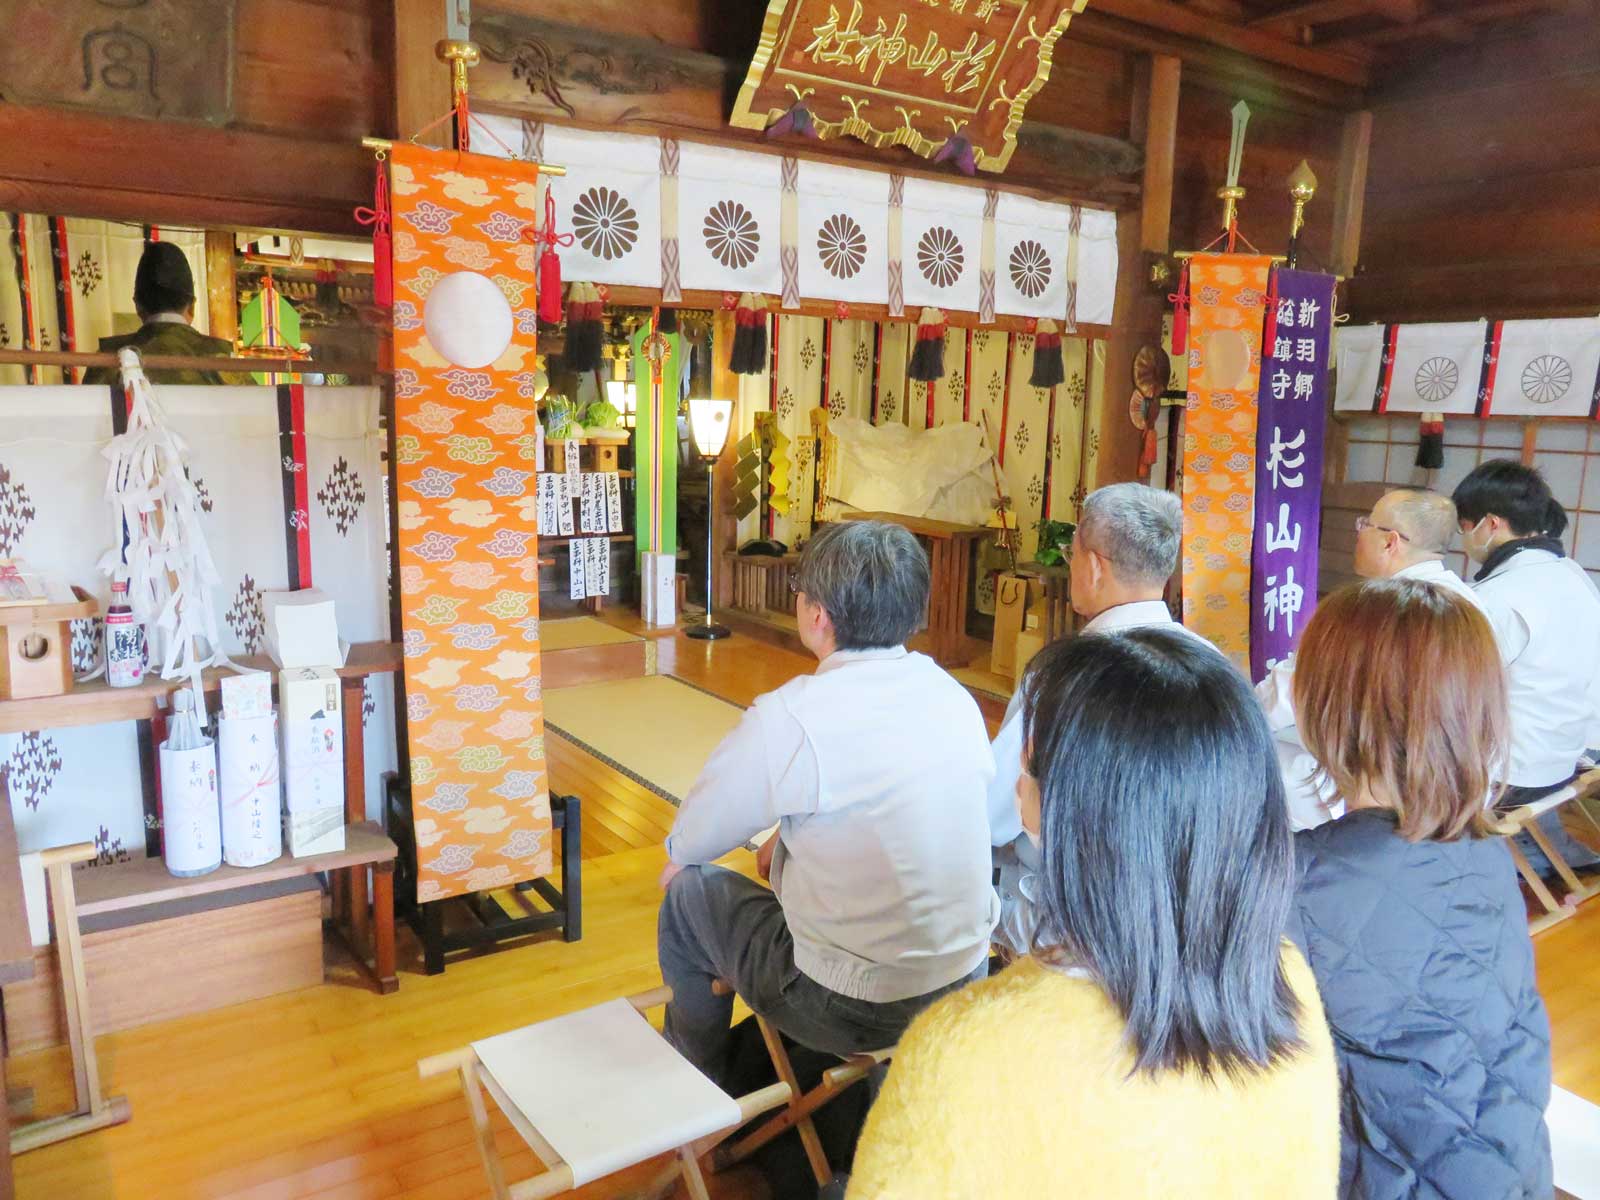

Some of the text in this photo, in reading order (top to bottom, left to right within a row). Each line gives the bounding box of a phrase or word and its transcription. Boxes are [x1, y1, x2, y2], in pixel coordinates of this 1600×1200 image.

[804, 0, 996, 94] 杉山神社
[1294, 298, 1321, 402] 新羽郷
[1264, 426, 1306, 668] 杉山神
